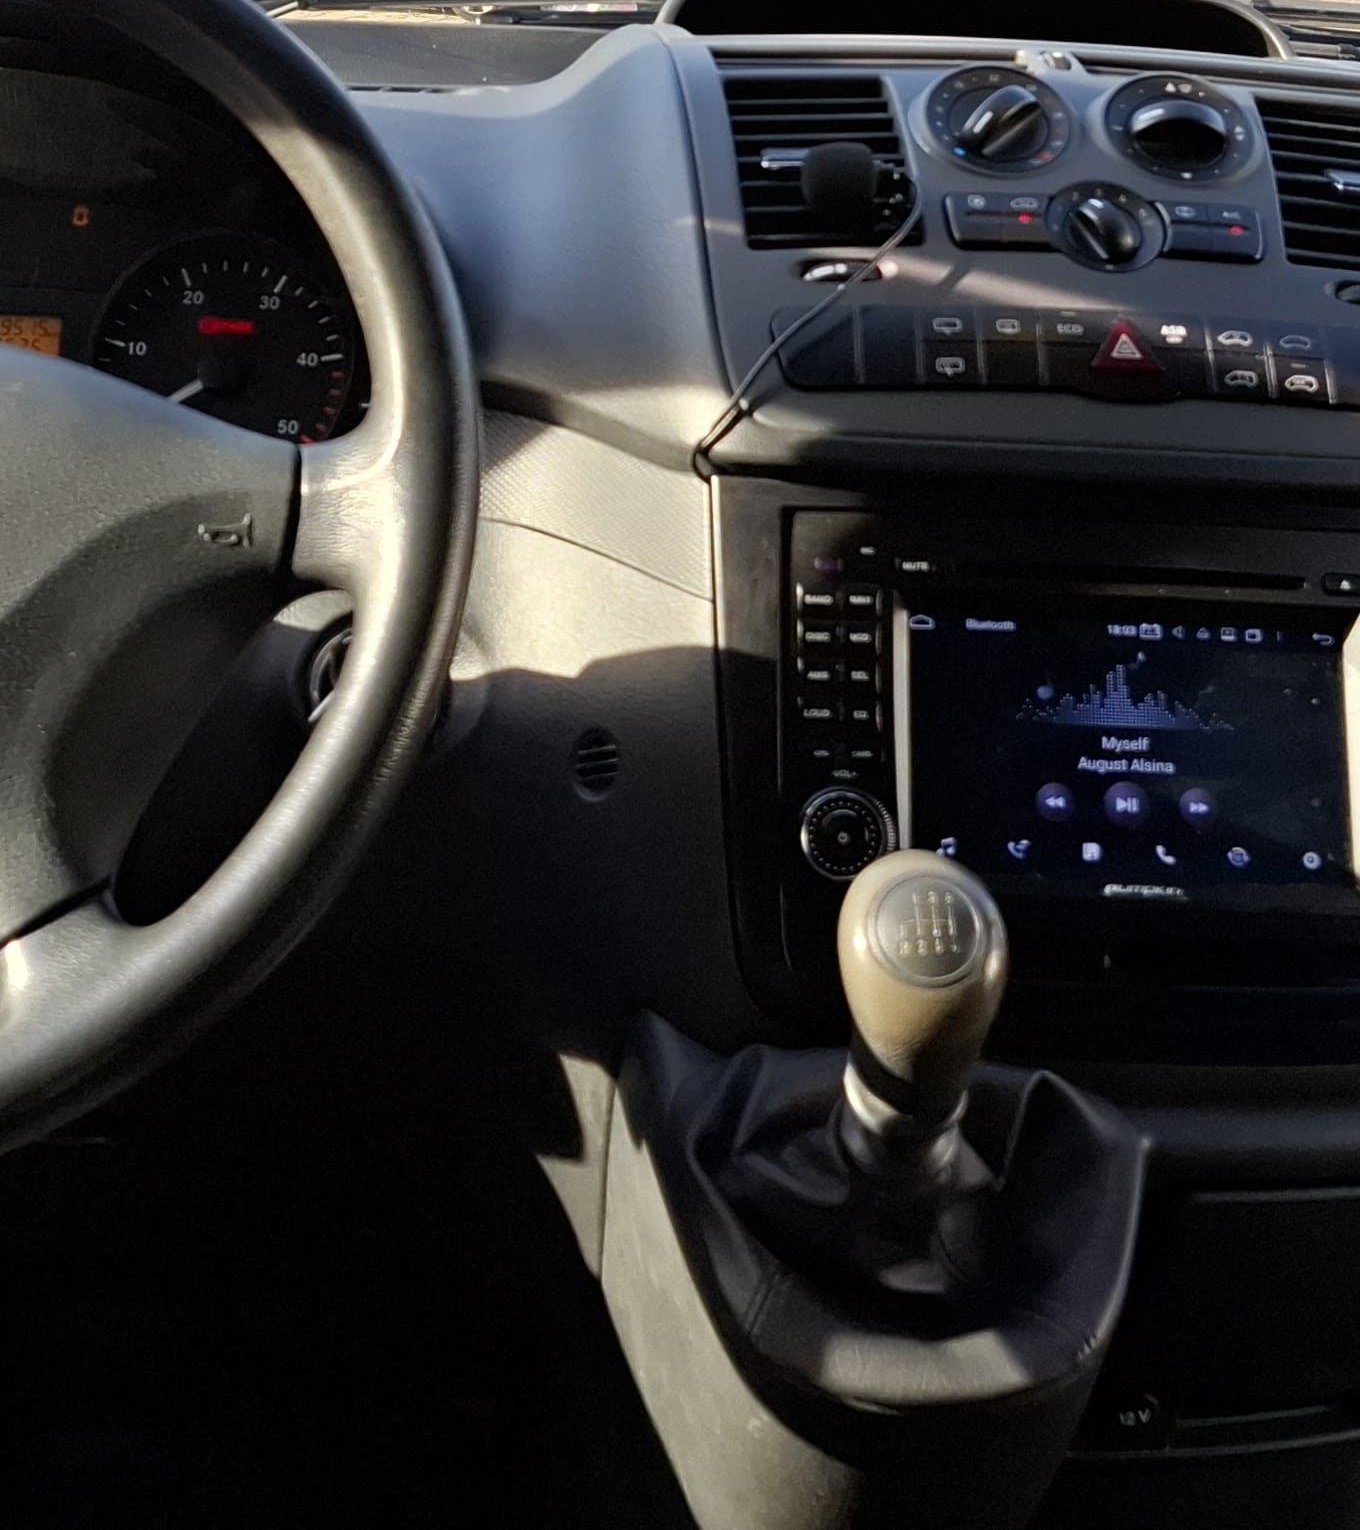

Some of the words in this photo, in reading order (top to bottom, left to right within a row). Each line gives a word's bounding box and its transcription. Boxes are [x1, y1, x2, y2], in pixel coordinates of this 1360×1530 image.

[183, 291, 204, 305] 20
[260, 295, 280, 309] 30
[127, 341, 147, 355] 10
[297, 353, 319, 367] 40
[278, 420, 299, 434] 50
[966, 619, 1016, 631] Bluetooth
[1102, 736, 1150, 752] Myself
[1078, 757, 1129, 774] August
[1130, 759, 1176, 774] Alsina
